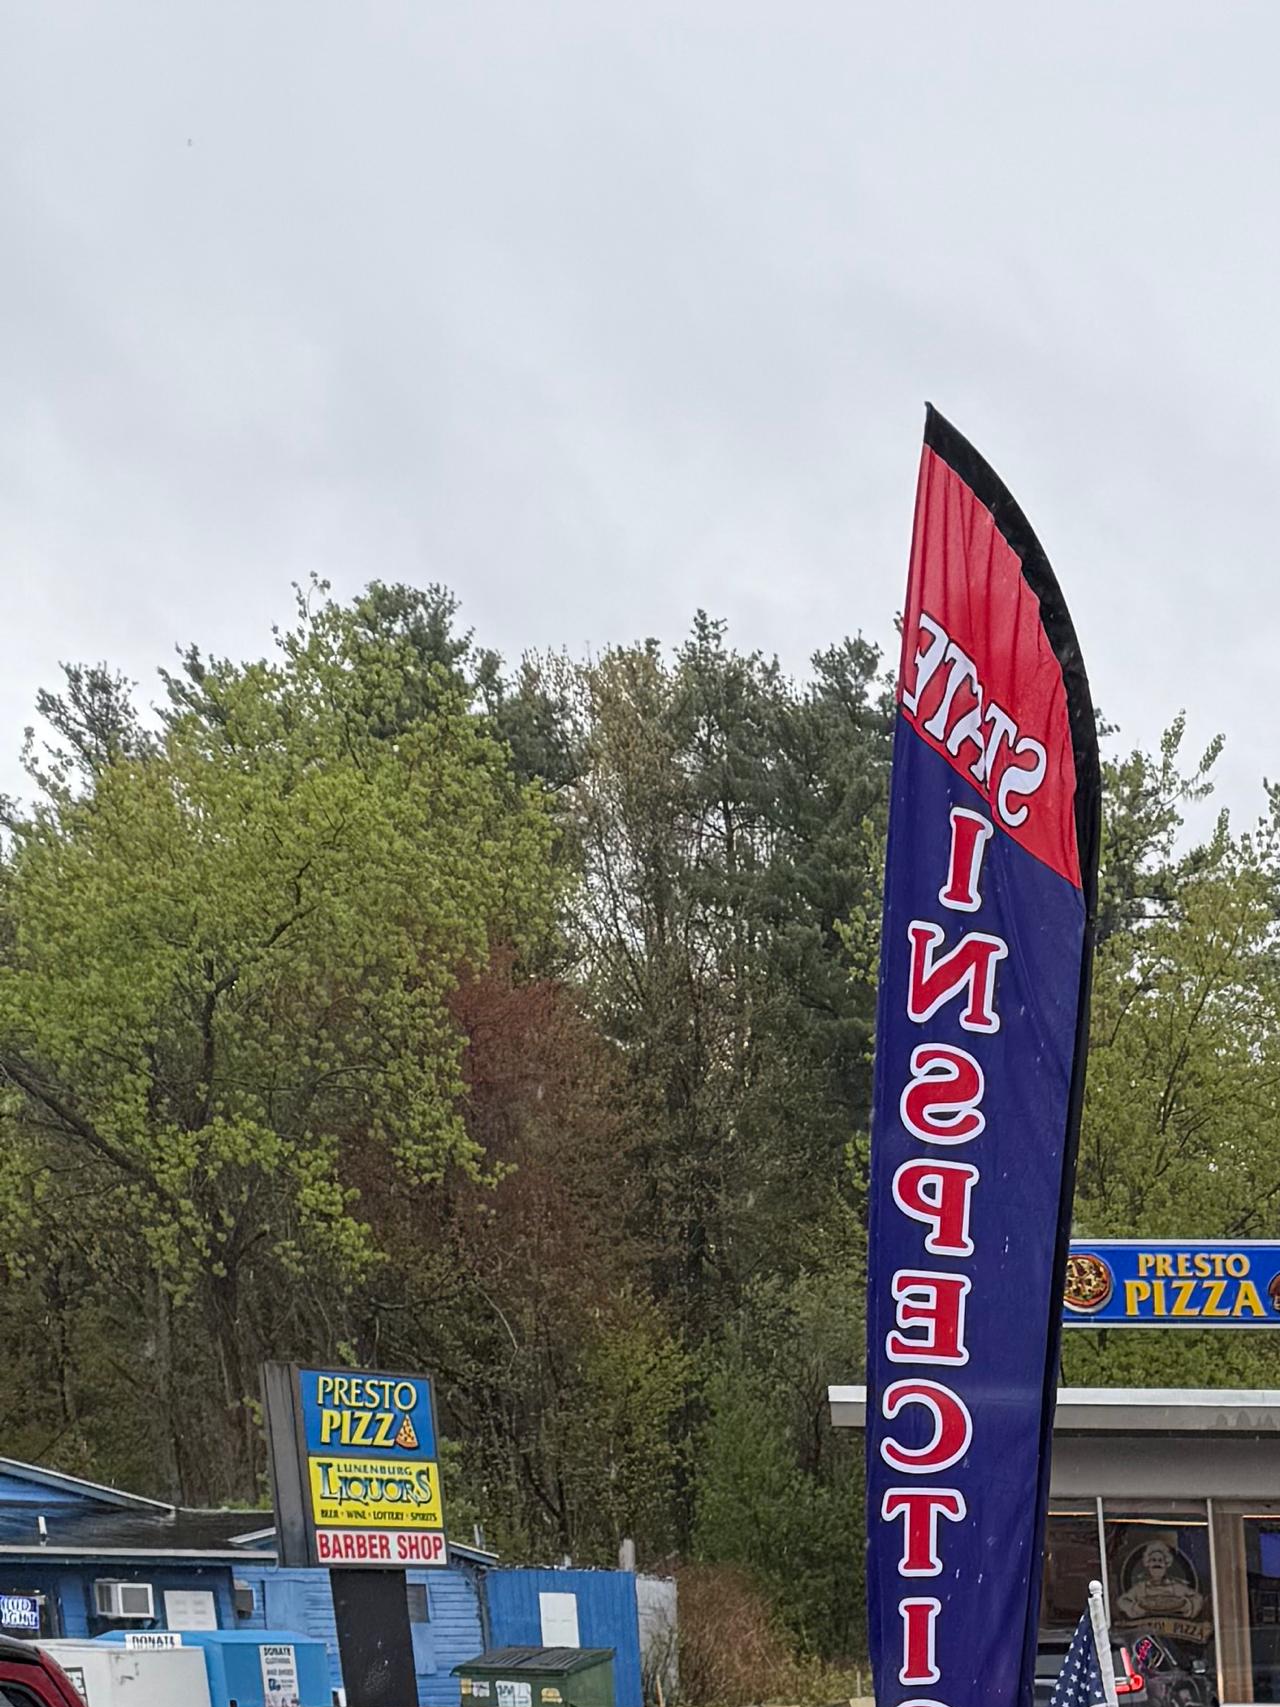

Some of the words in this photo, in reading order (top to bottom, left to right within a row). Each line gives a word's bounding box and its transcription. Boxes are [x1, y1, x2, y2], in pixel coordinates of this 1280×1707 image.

[1137, 1253, 1251, 1278] PRESTO
[1124, 1280, 1268, 1317] PIZZA
[316, 1375, 417, 1411] PRESTO
[337, 1464, 412, 1476] LUNENBURG
[318, 1533, 391, 1560] BARBER
[397, 1534, 444, 1560] SHOP
